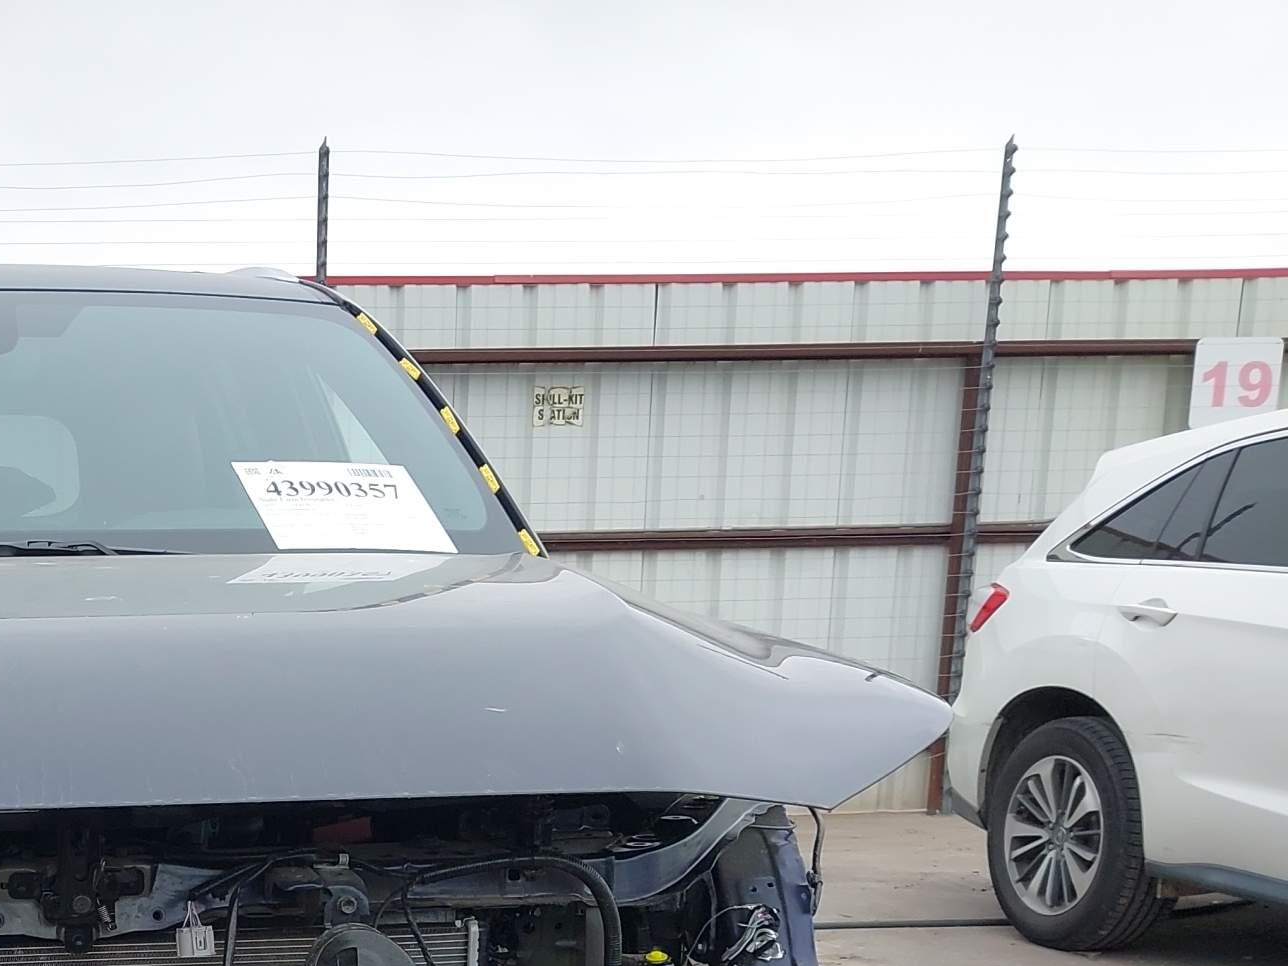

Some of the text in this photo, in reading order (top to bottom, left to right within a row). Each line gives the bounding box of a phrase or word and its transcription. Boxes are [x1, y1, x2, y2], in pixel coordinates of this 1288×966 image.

[1202, 360, 1273, 408] 19
[537, 408, 580, 421] SATIN
[266, 479, 399, 500] 43990357
